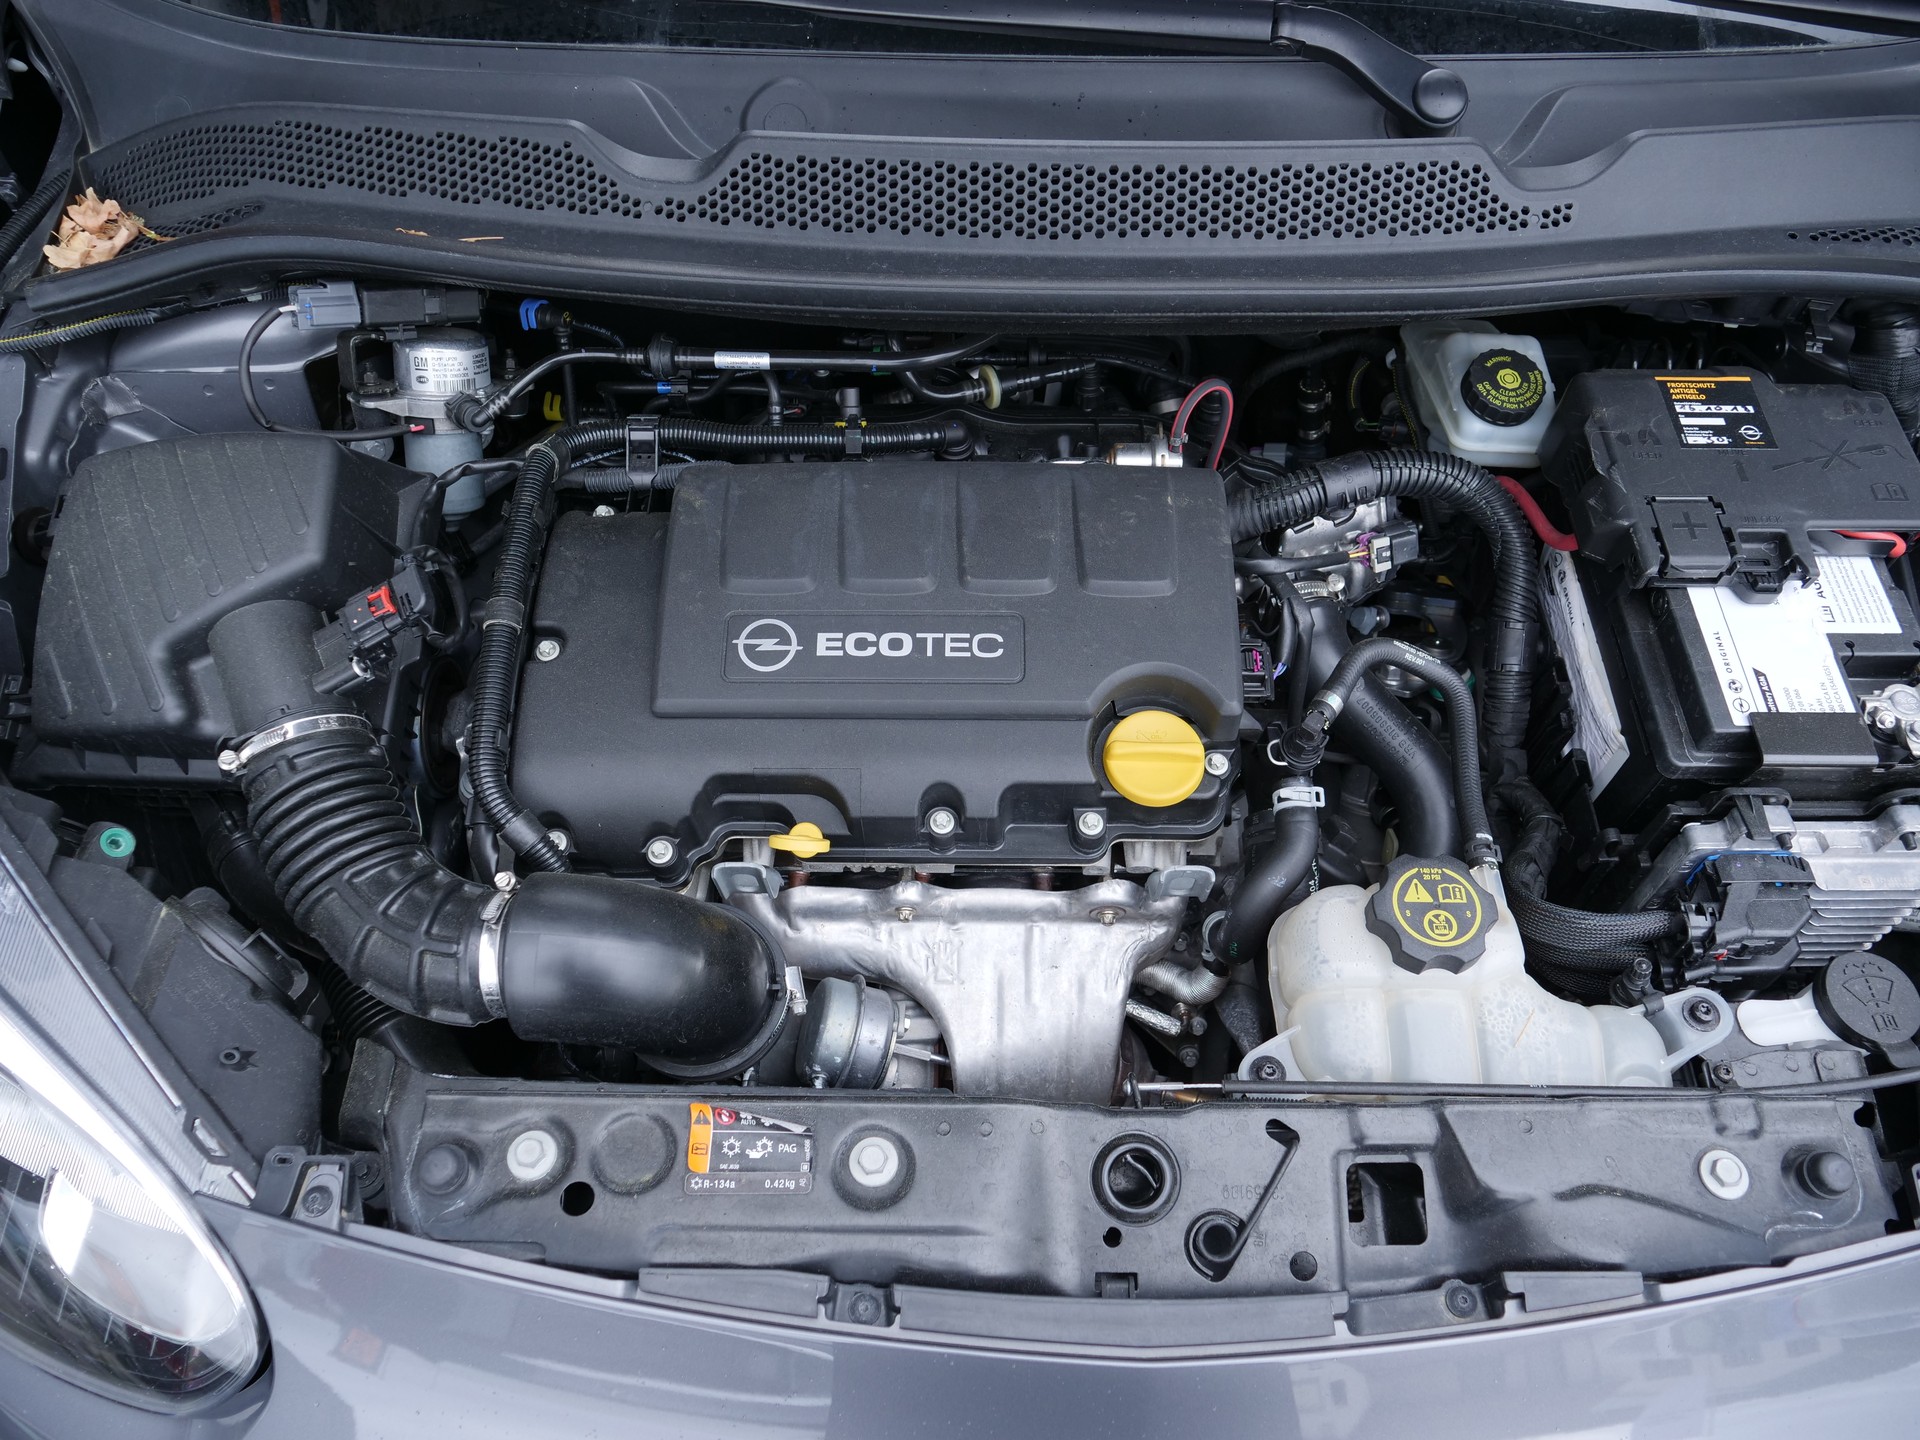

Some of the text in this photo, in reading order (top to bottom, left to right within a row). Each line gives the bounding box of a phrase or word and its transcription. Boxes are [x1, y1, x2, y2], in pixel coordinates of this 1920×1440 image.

[414, 356, 428, 368] GM
[1500, 388, 1516, 396] CLEAN
[1487, 394, 1502, 406] FLUID
[816, 632, 1004, 658] ECOTEC
[1712, 631, 1732, 674] ORIGINAL
[778, 1144, 797, 1153] PAG
[703, 1180, 736, 1188] R-134a
